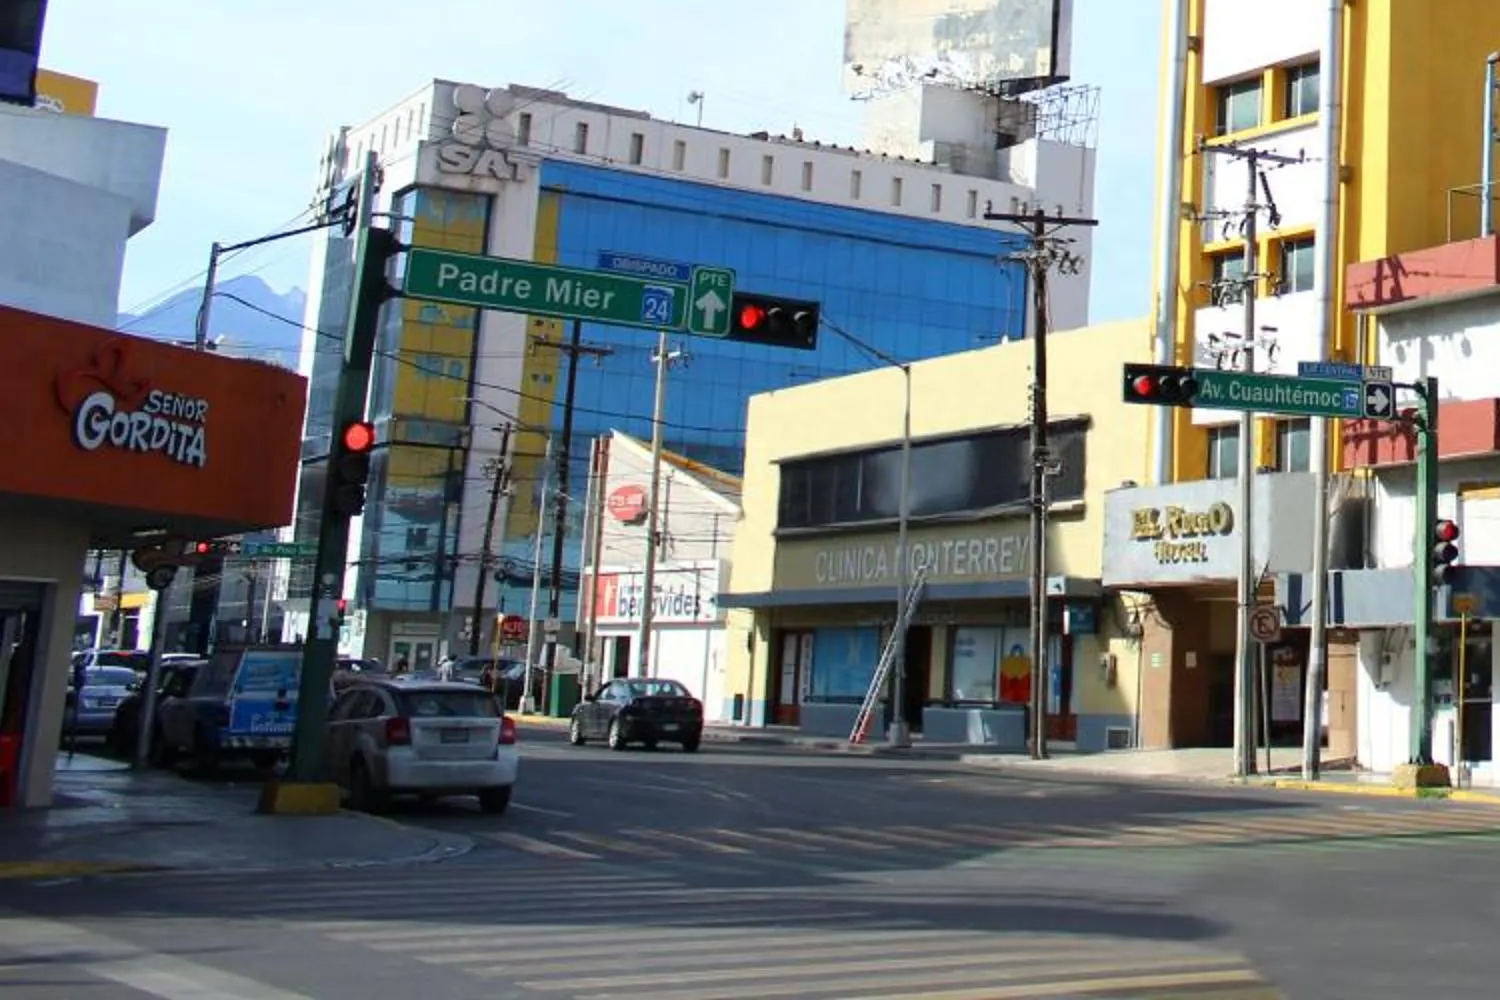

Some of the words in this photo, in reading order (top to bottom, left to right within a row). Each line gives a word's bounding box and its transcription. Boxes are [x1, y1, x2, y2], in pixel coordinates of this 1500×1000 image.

[437, 142, 539, 183] SAT
[437, 263, 532, 299] Padre
[545, 278, 615, 309] Mier
[645, 296, 668, 322] 24
[700, 272, 726, 288] PTE
[144, 390, 208, 422] SEÑOR
[1201, 379, 1224, 399] Av.
[1229, 381, 1341, 407] Cuauhtémoc
